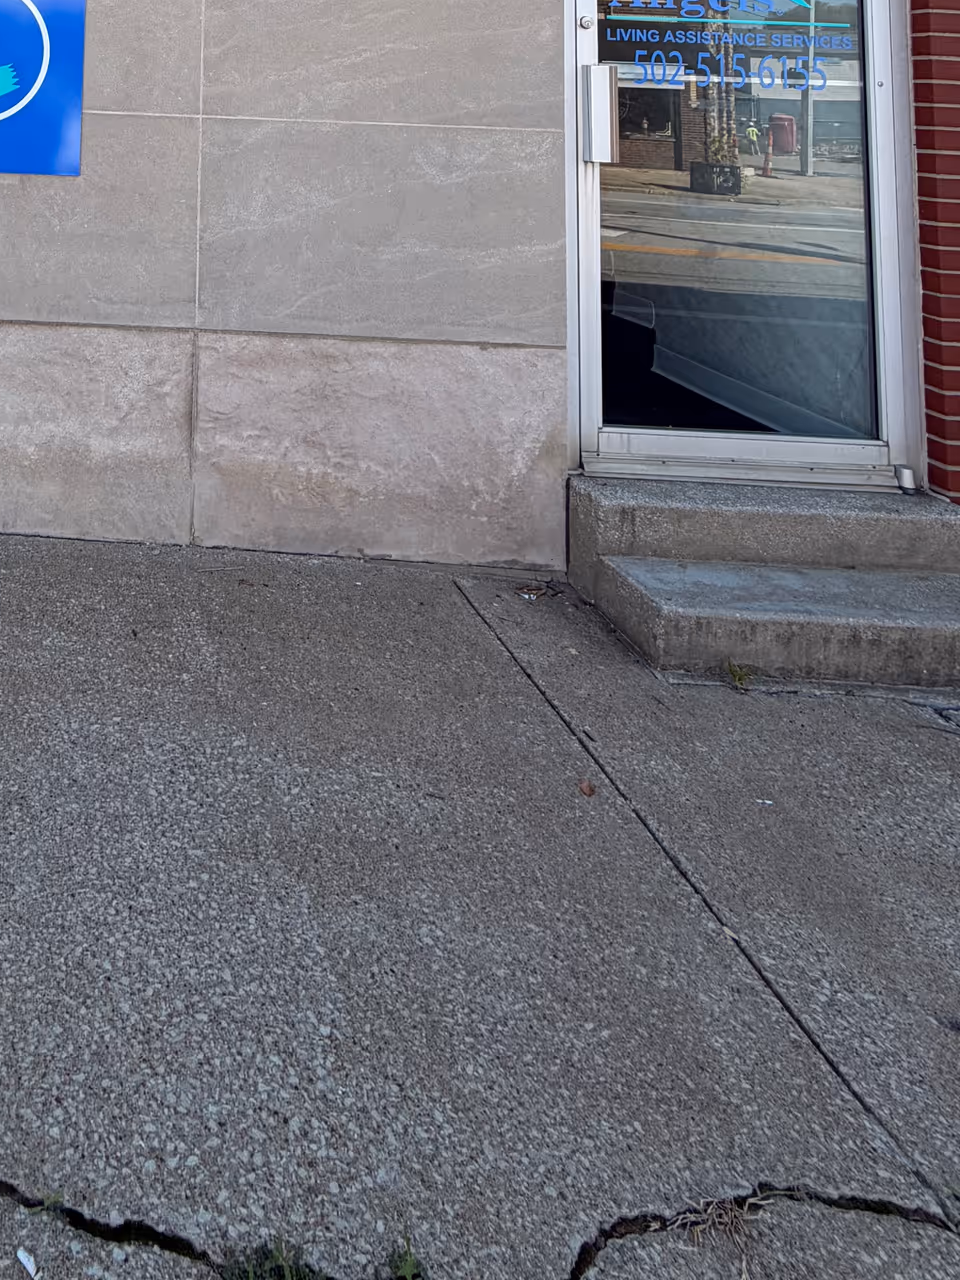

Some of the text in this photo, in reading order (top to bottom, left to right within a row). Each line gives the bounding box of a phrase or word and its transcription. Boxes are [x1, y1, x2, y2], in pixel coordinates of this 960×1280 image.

[606, 28, 853, 50] LIVING ASSISTANCE SERVICES
[633, 50, 827, 91] 502-515-6155
